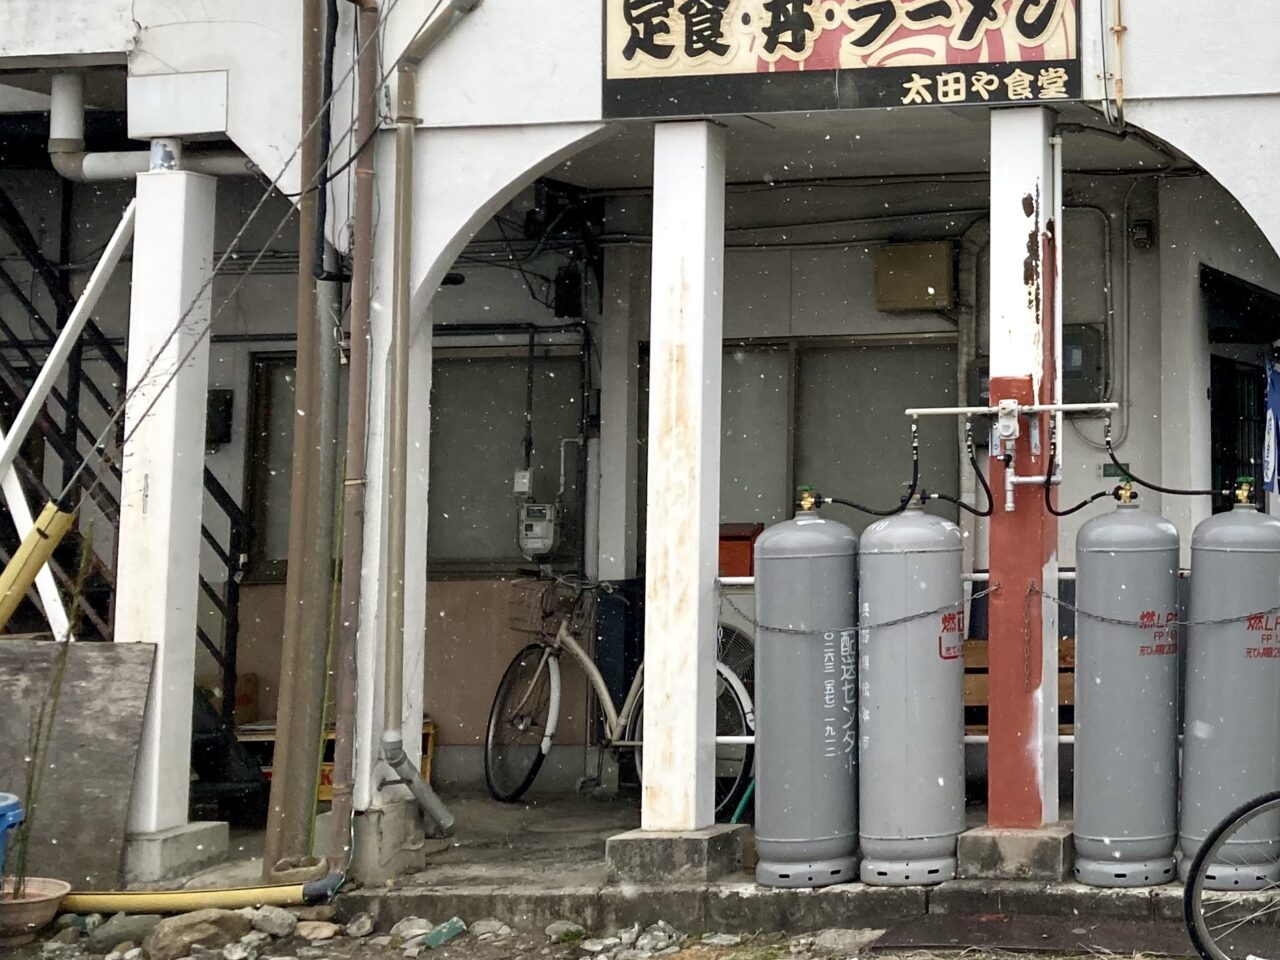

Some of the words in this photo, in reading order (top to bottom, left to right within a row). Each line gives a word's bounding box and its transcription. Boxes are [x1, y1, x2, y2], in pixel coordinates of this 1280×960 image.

[902, 67, 1069, 104] 太田や食堂
